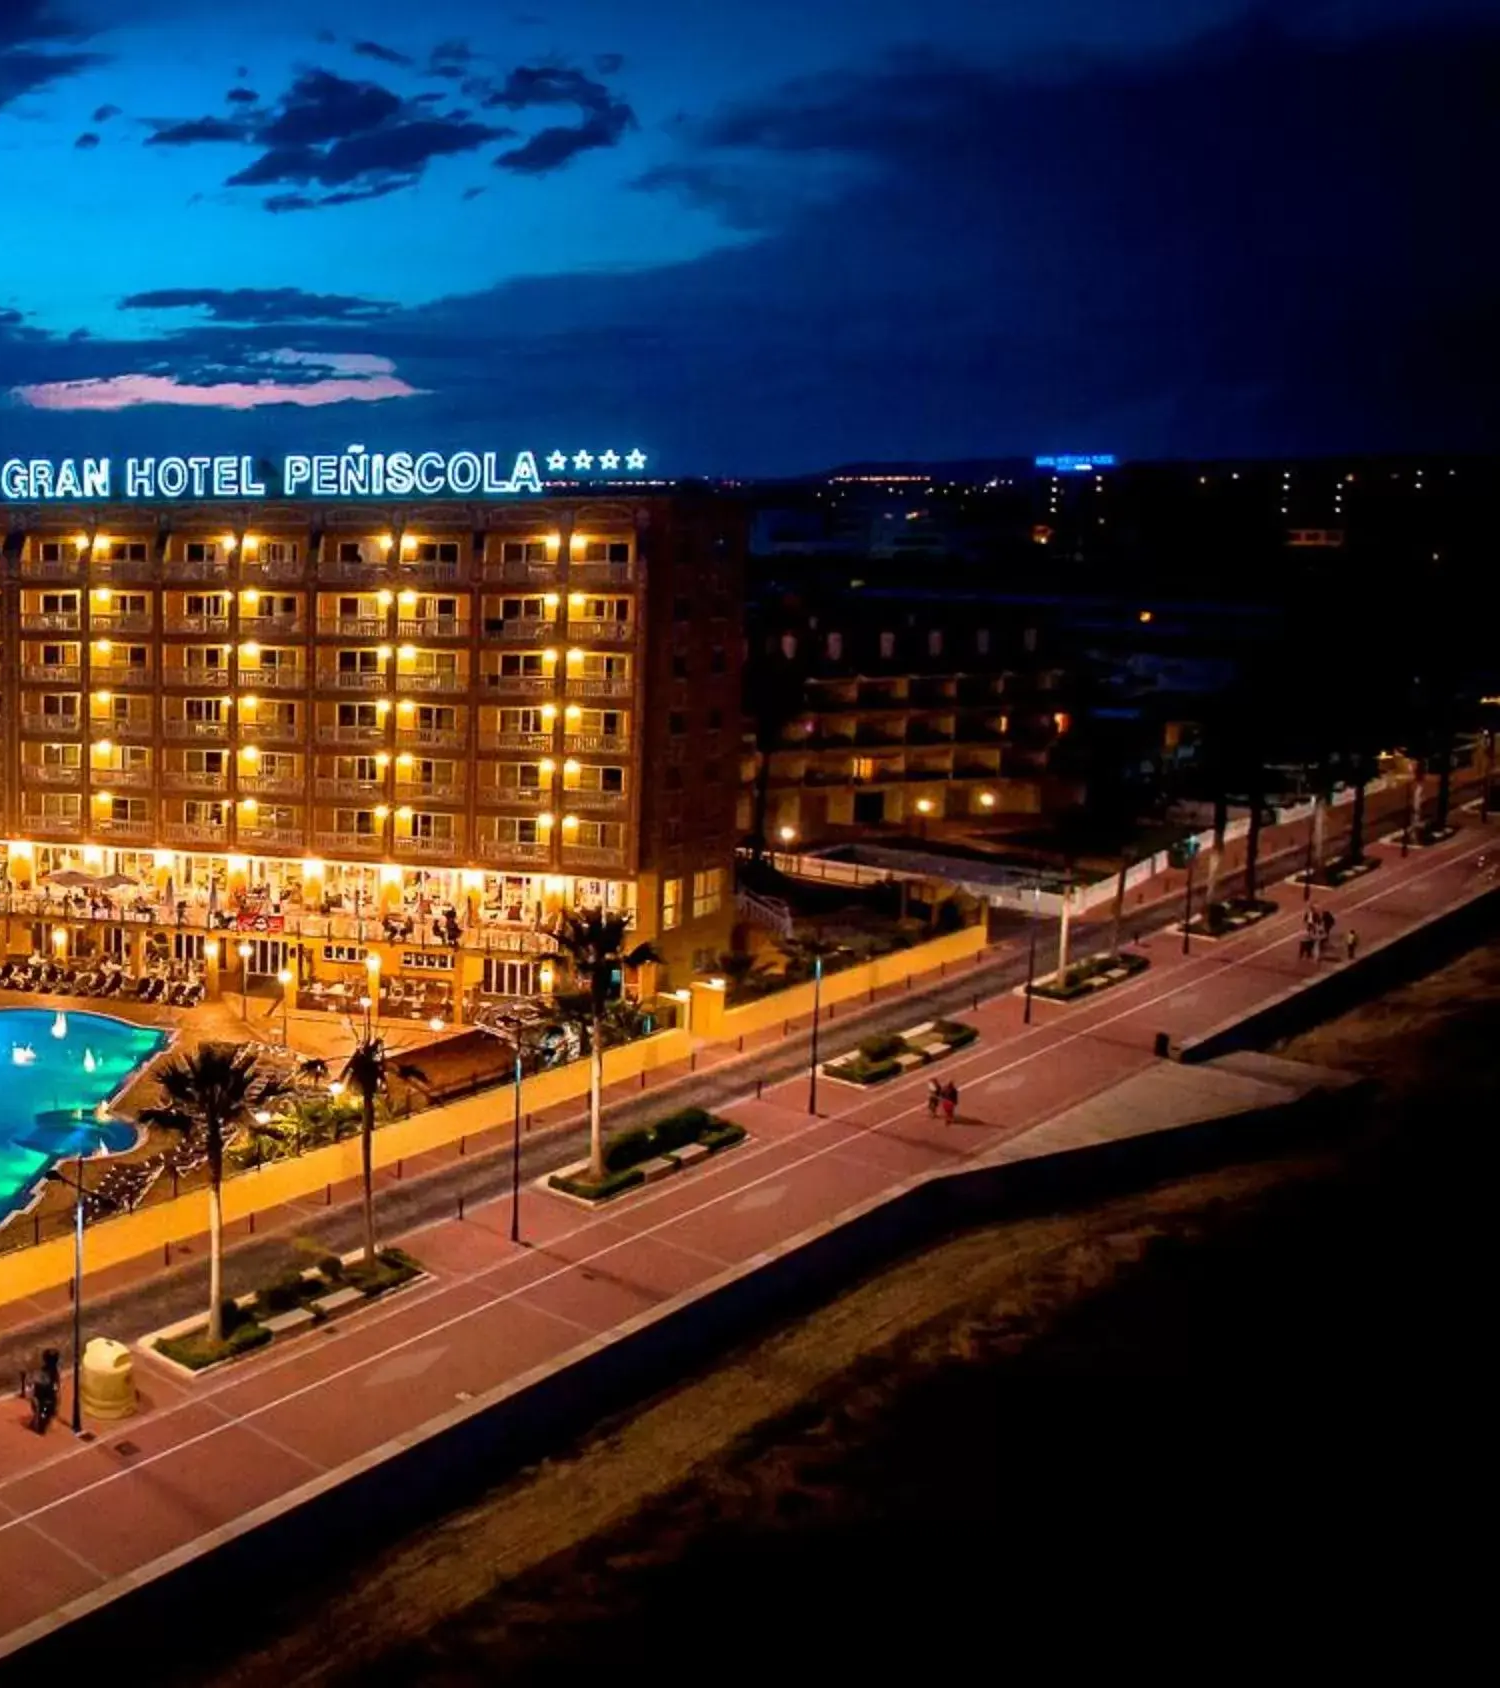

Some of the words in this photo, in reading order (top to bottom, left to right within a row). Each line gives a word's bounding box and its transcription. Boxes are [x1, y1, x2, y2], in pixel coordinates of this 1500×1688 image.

[1, 458, 110, 498] GRAN
[126, 455, 265, 497] HOTEL
[284, 444, 542, 495] PEÑISCOLA
